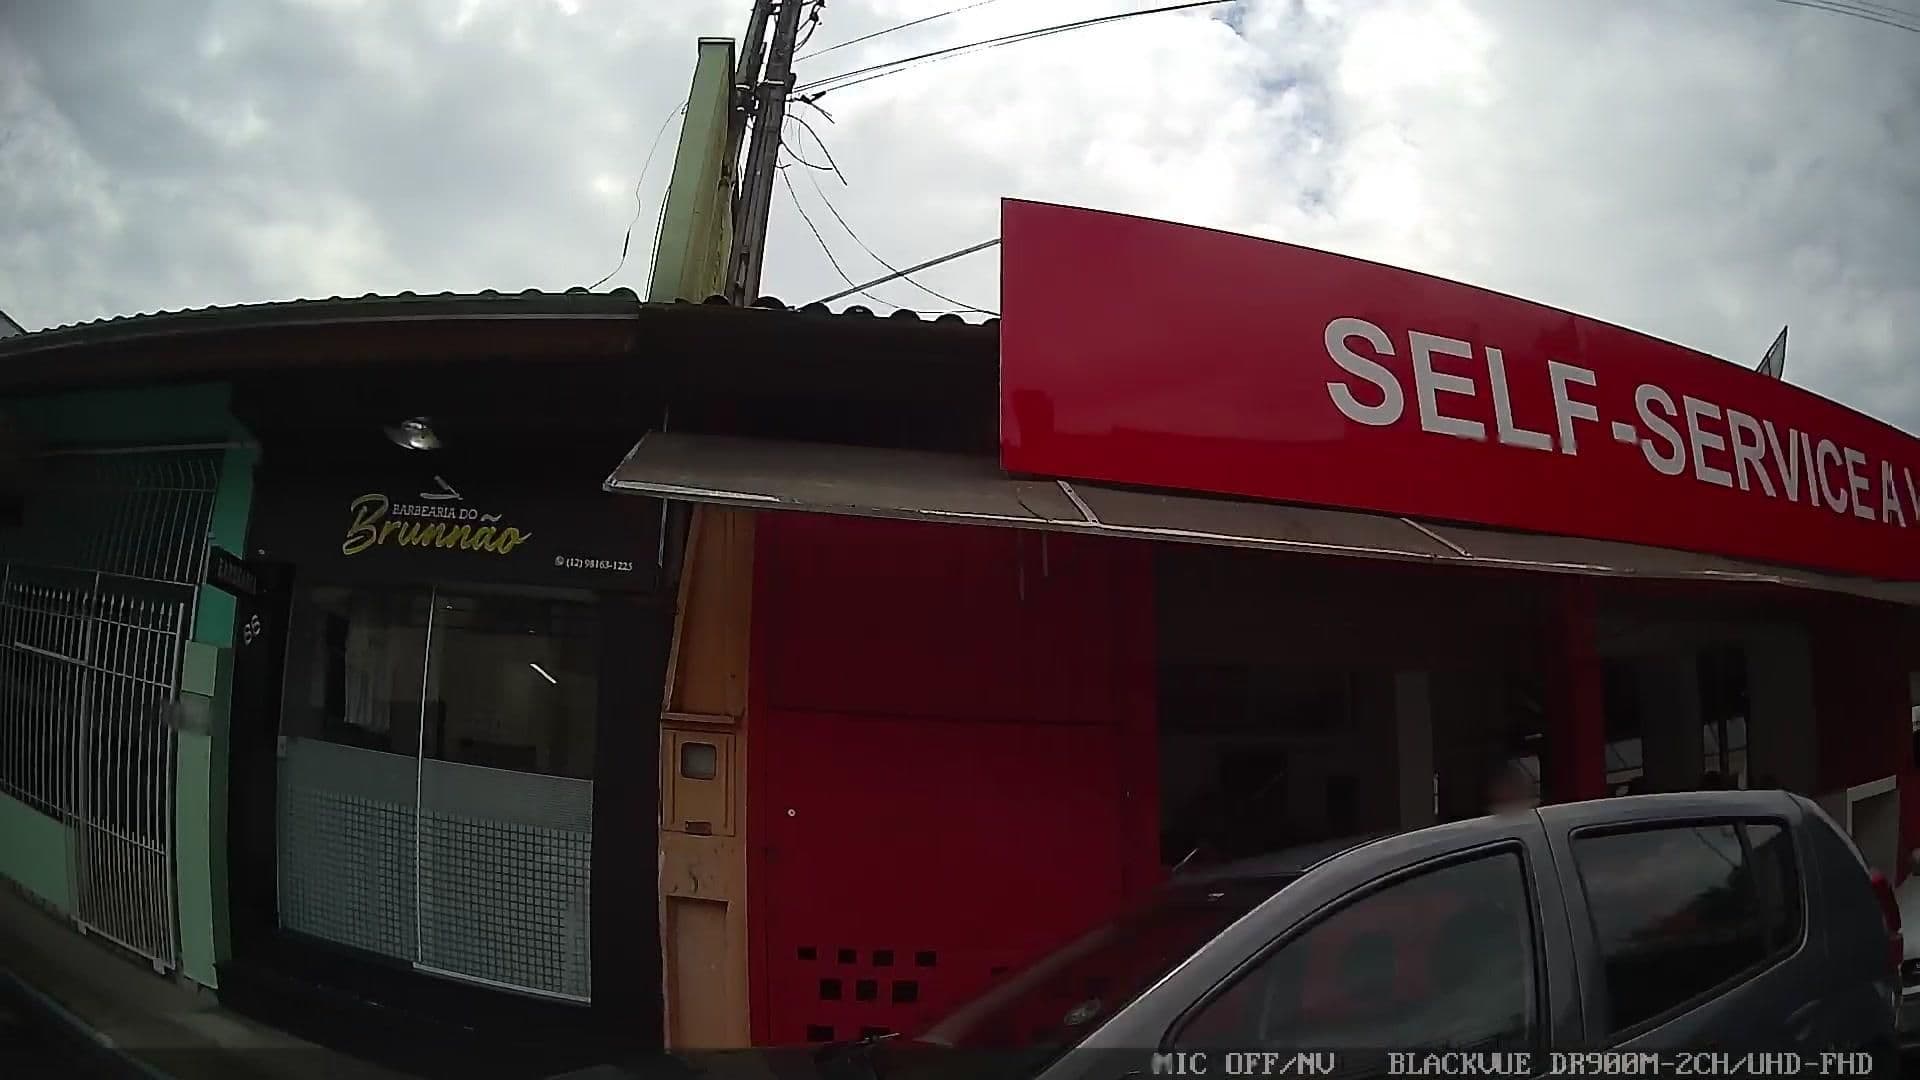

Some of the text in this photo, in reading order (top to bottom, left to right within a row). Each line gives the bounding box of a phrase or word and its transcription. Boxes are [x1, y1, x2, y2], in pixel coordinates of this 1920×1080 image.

[1323, 317, 1876, 521] SELF-SERVICE
[1881, 459, 1907, 528] A
[342, 493, 532, 555] Brunnão
[391, 503, 478, 520] BARBEARIA DO
[566, 557, 583, 569] (12)
